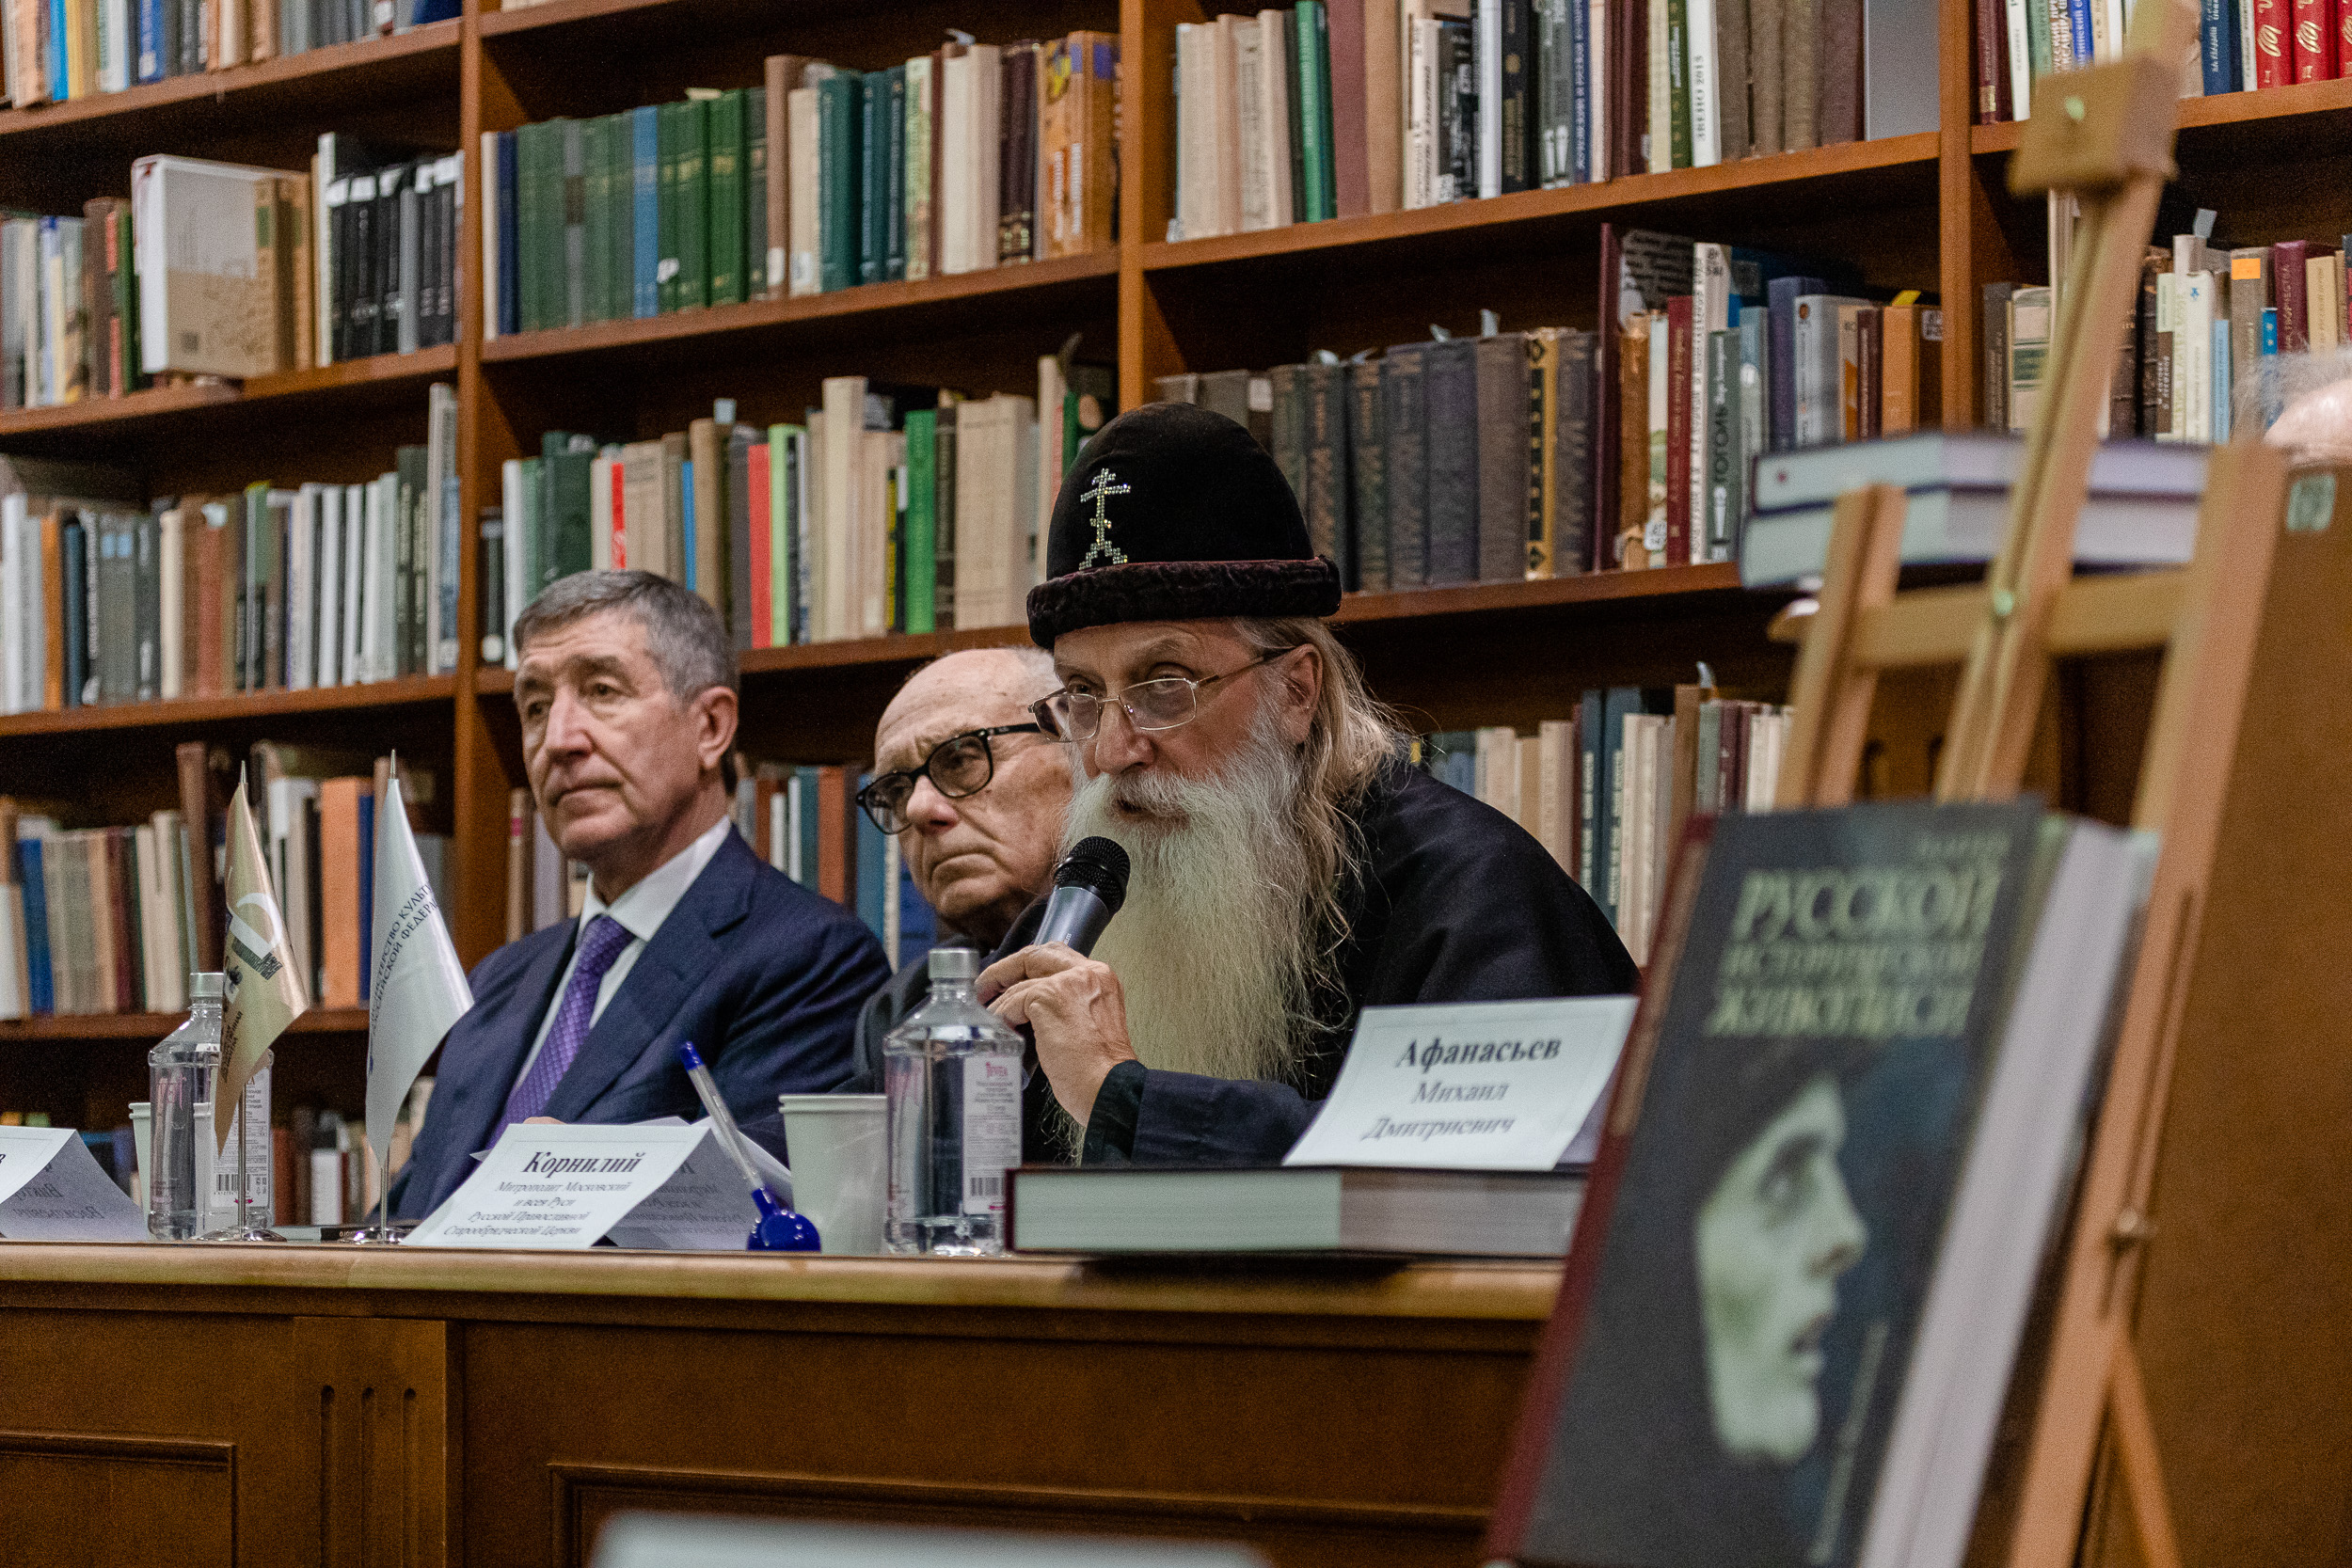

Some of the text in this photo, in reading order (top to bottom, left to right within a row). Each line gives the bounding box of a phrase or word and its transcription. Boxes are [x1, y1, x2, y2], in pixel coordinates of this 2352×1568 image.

[1713, 405, 1727, 485] ГОГОЛЬ
[1394, 1037, 1562, 1073] Афанасьев
[1410, 1082, 1509, 1104] Михаил
[1360, 1116, 1516, 1142] Дмитриевич
[521, 1150, 646, 1179] Корнилий
[494, 1181, 632, 1195] Митрополит Московский
[547, 1196, 577, 1208] Руси
[467, 1211, 592, 1223] Русской Православной
